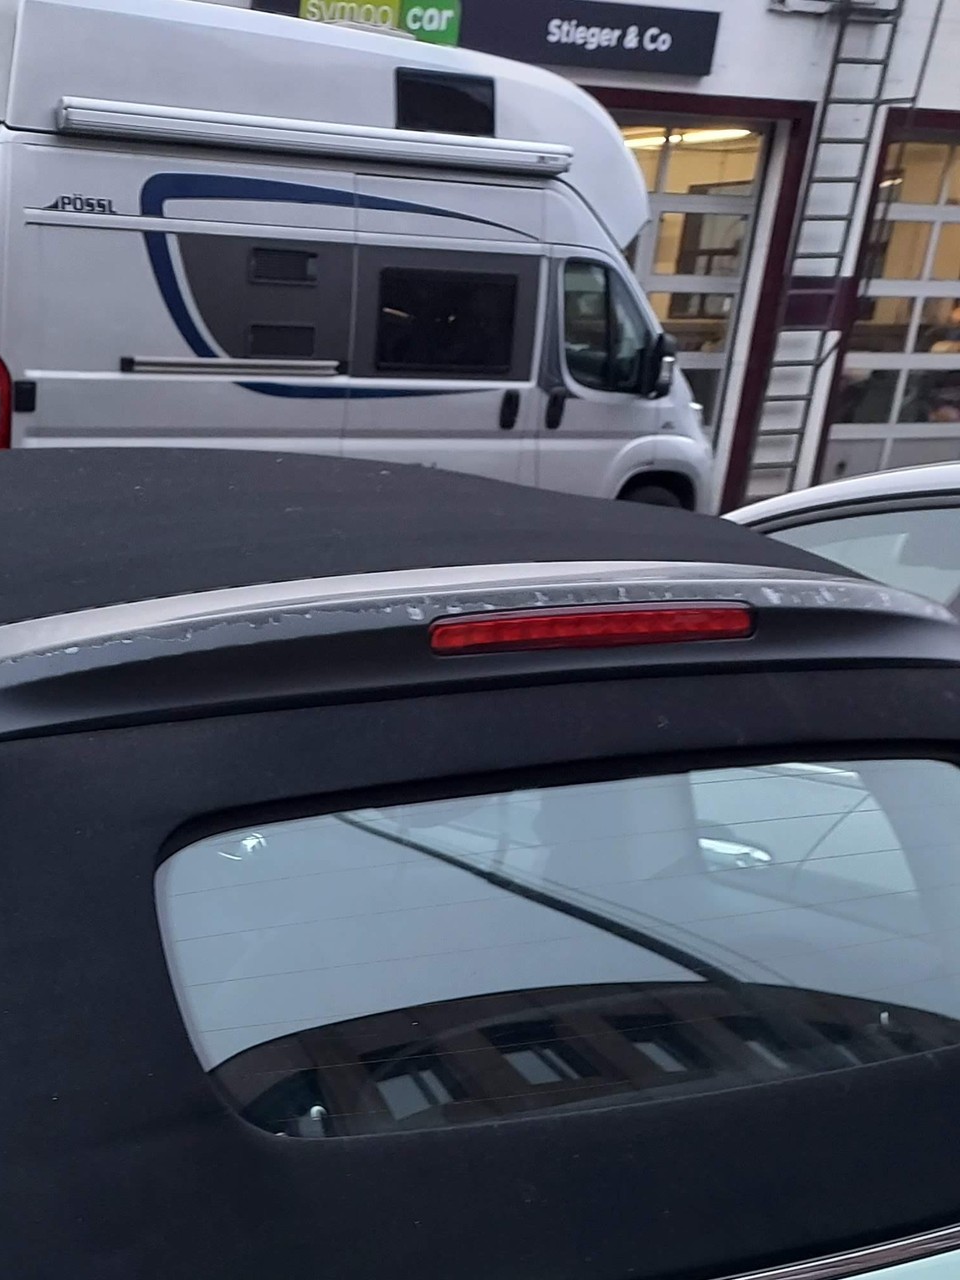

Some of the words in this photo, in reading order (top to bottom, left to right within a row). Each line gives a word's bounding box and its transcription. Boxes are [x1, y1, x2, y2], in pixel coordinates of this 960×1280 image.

[406, 6, 454, 31] car
[546, 18, 622, 50] Stieger
[623, 25, 639, 49] &
[643, 27, 672, 51] Co
[60, 192, 117, 214] PÖSSL
